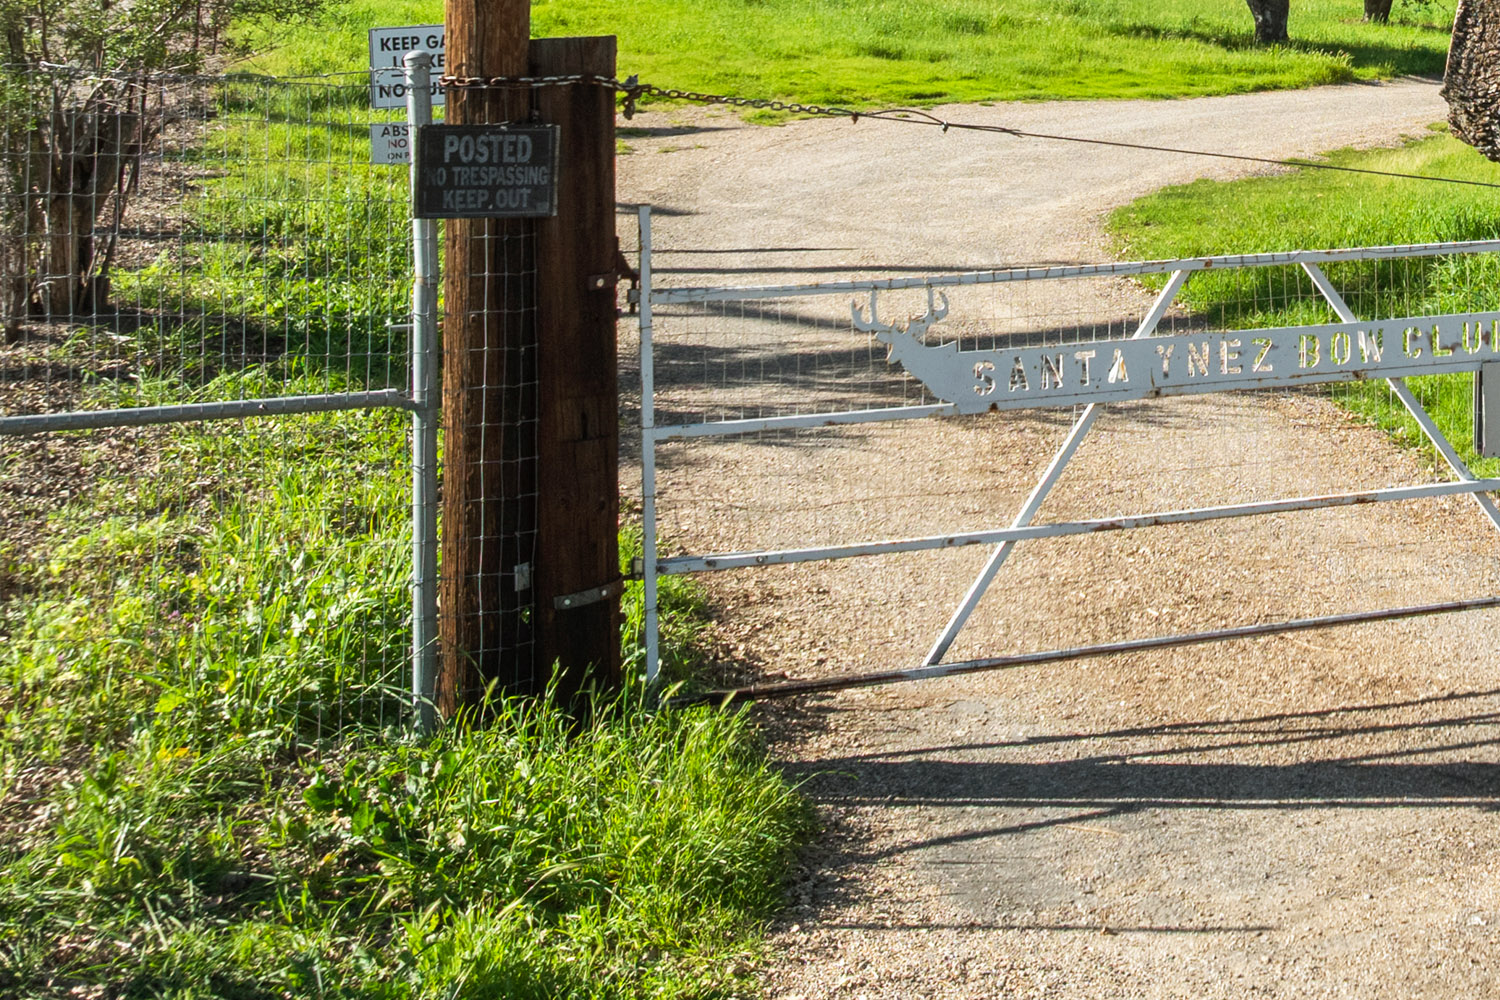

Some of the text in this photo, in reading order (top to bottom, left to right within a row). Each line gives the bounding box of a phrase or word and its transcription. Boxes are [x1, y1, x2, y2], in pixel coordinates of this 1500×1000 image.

[380, 36, 420, 51] KEEP
[444, 135, 532, 163] POSTED
[425, 166, 548, 186] NO TRESPASSING
[442, 188, 532, 209] KEEP OUT
[972, 348, 1129, 396] SANTA
[1156, 337, 1273, 378] YNEZ
[1298, 327, 1384, 368] BOW
